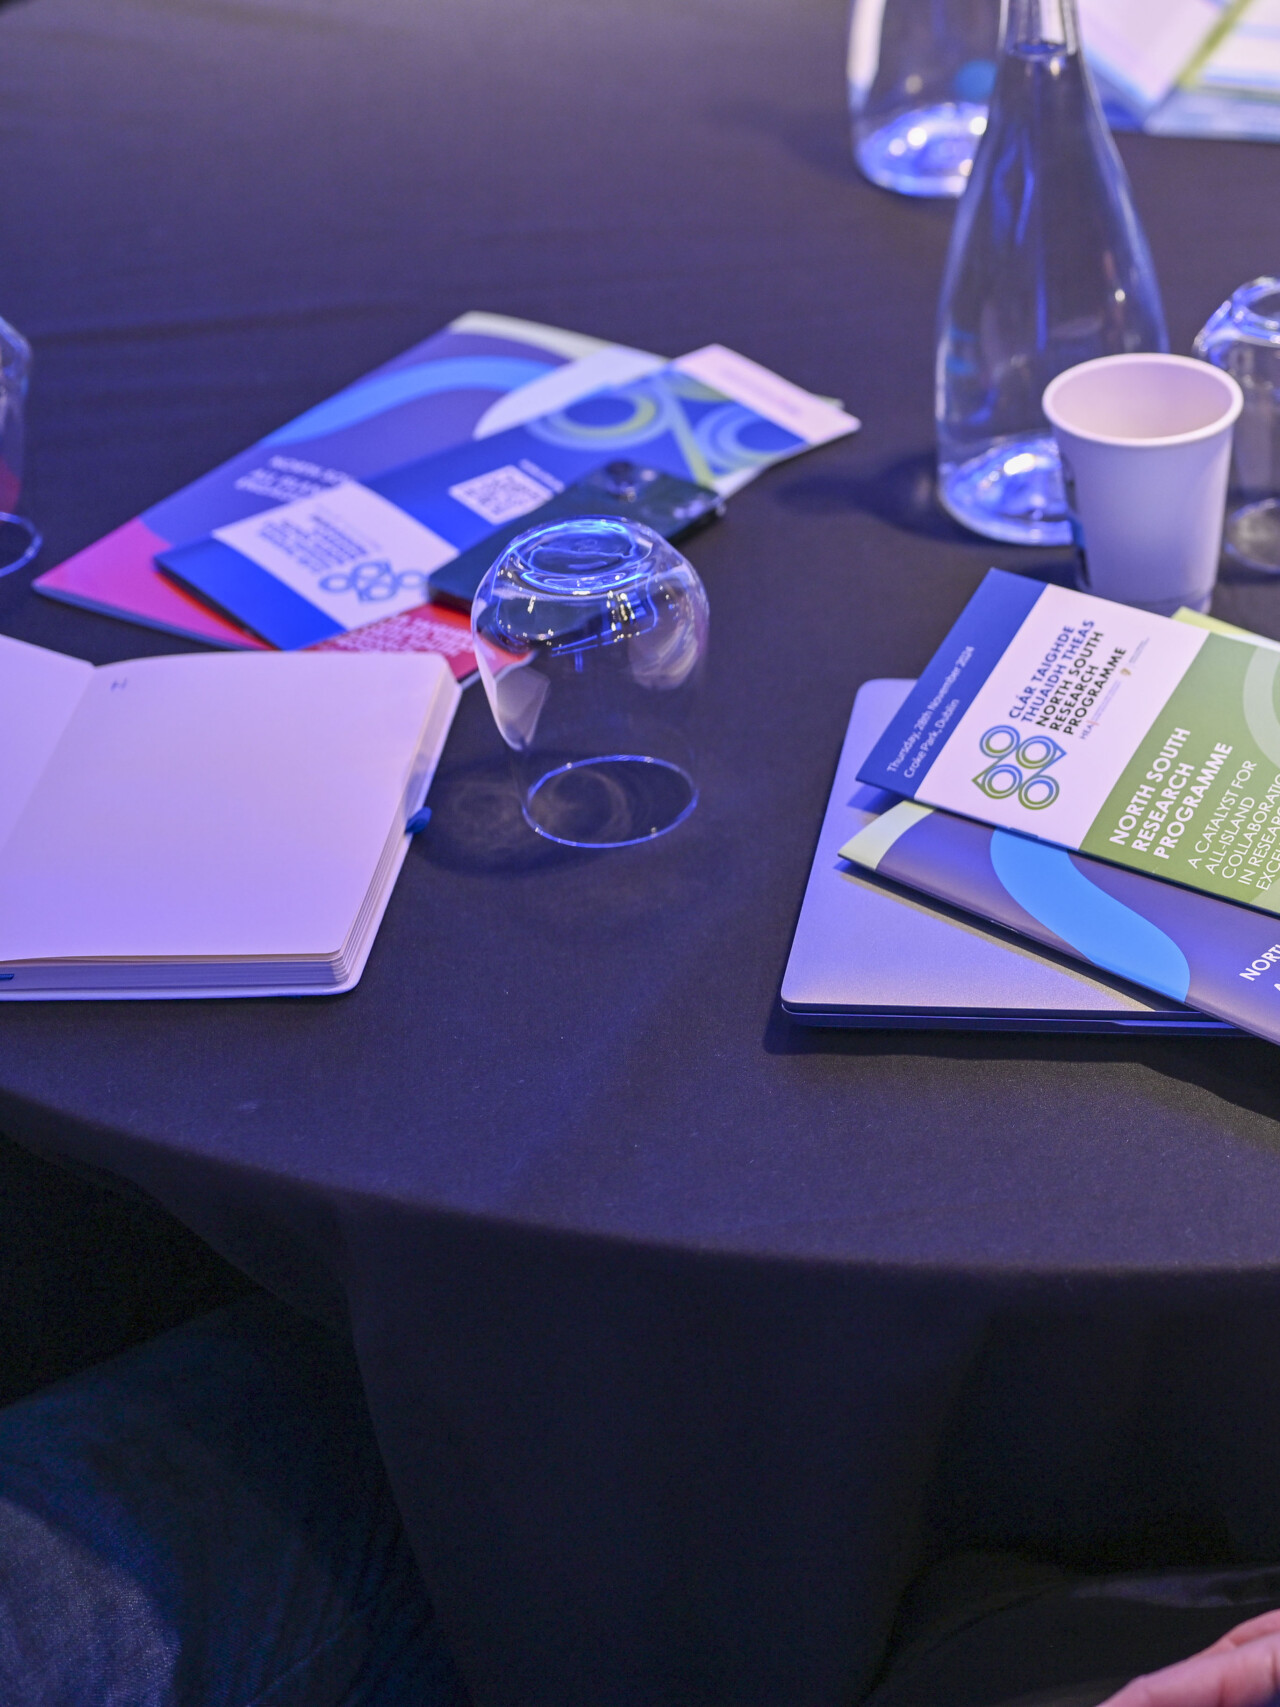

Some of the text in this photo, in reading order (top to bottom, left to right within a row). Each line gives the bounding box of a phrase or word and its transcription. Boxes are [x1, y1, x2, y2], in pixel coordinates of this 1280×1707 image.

[1009, 626, 1074, 719] CLÁR TAIGHDE
[1021, 620, 1094, 722] THUAIDH THEAS
[1036, 631, 1104, 727] NORTH SOUTH
[1049, 665, 1099, 731] RESEARCH
[1063, 647, 1127, 735] PROGRAMME
[887, 731, 921, 772] Thursday,
[927, 666, 962, 710] November
[903, 698, 960, 778] Croke Park, Dublin
[1109, 727, 1191, 845] NORTH SOUTH
[1131, 762, 1195, 852] RESEARCH
[1153, 742, 1233, 859] PROGRAMME
[1188, 760, 1257, 869] A CATALYST FOR
[1205, 796, 1255, 875] ALL-ISLAND
[1238, 869, 1256, 885] IN
